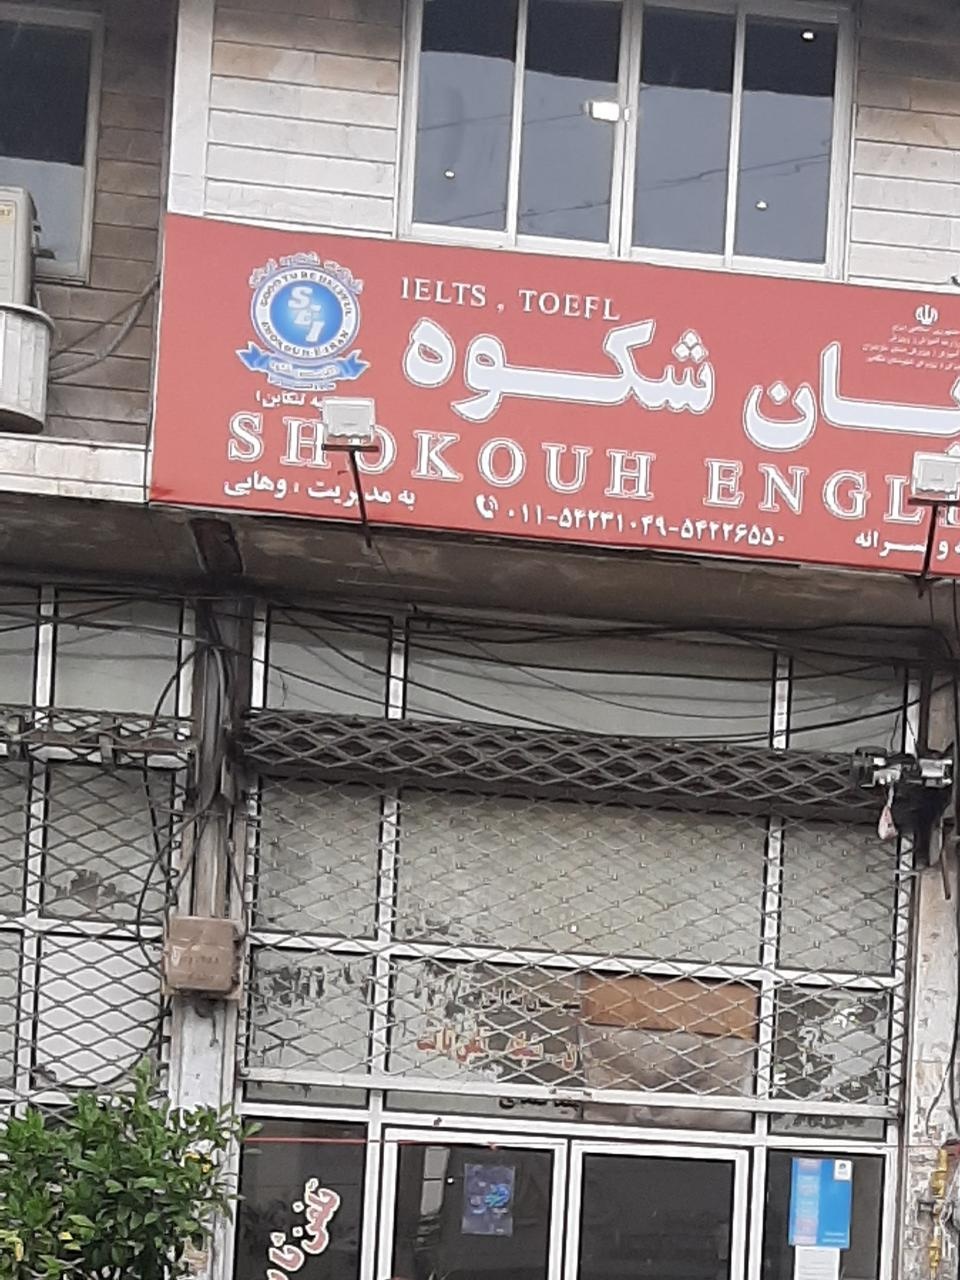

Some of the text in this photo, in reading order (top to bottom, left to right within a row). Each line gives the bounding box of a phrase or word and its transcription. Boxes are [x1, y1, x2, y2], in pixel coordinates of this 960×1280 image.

[518, 289, 621, 322] TOEFL
[403, 317, 714, 422] شکوه
[227, 411, 654, 501] SHOKOUH
[223, 470, 288, 499] وهابی
[397, 488, 416, 511] به
[854, 530, 928, 557] رانه
[936, 540, 949, 560] و
[292, 1177, 341, 1255] تلفن
